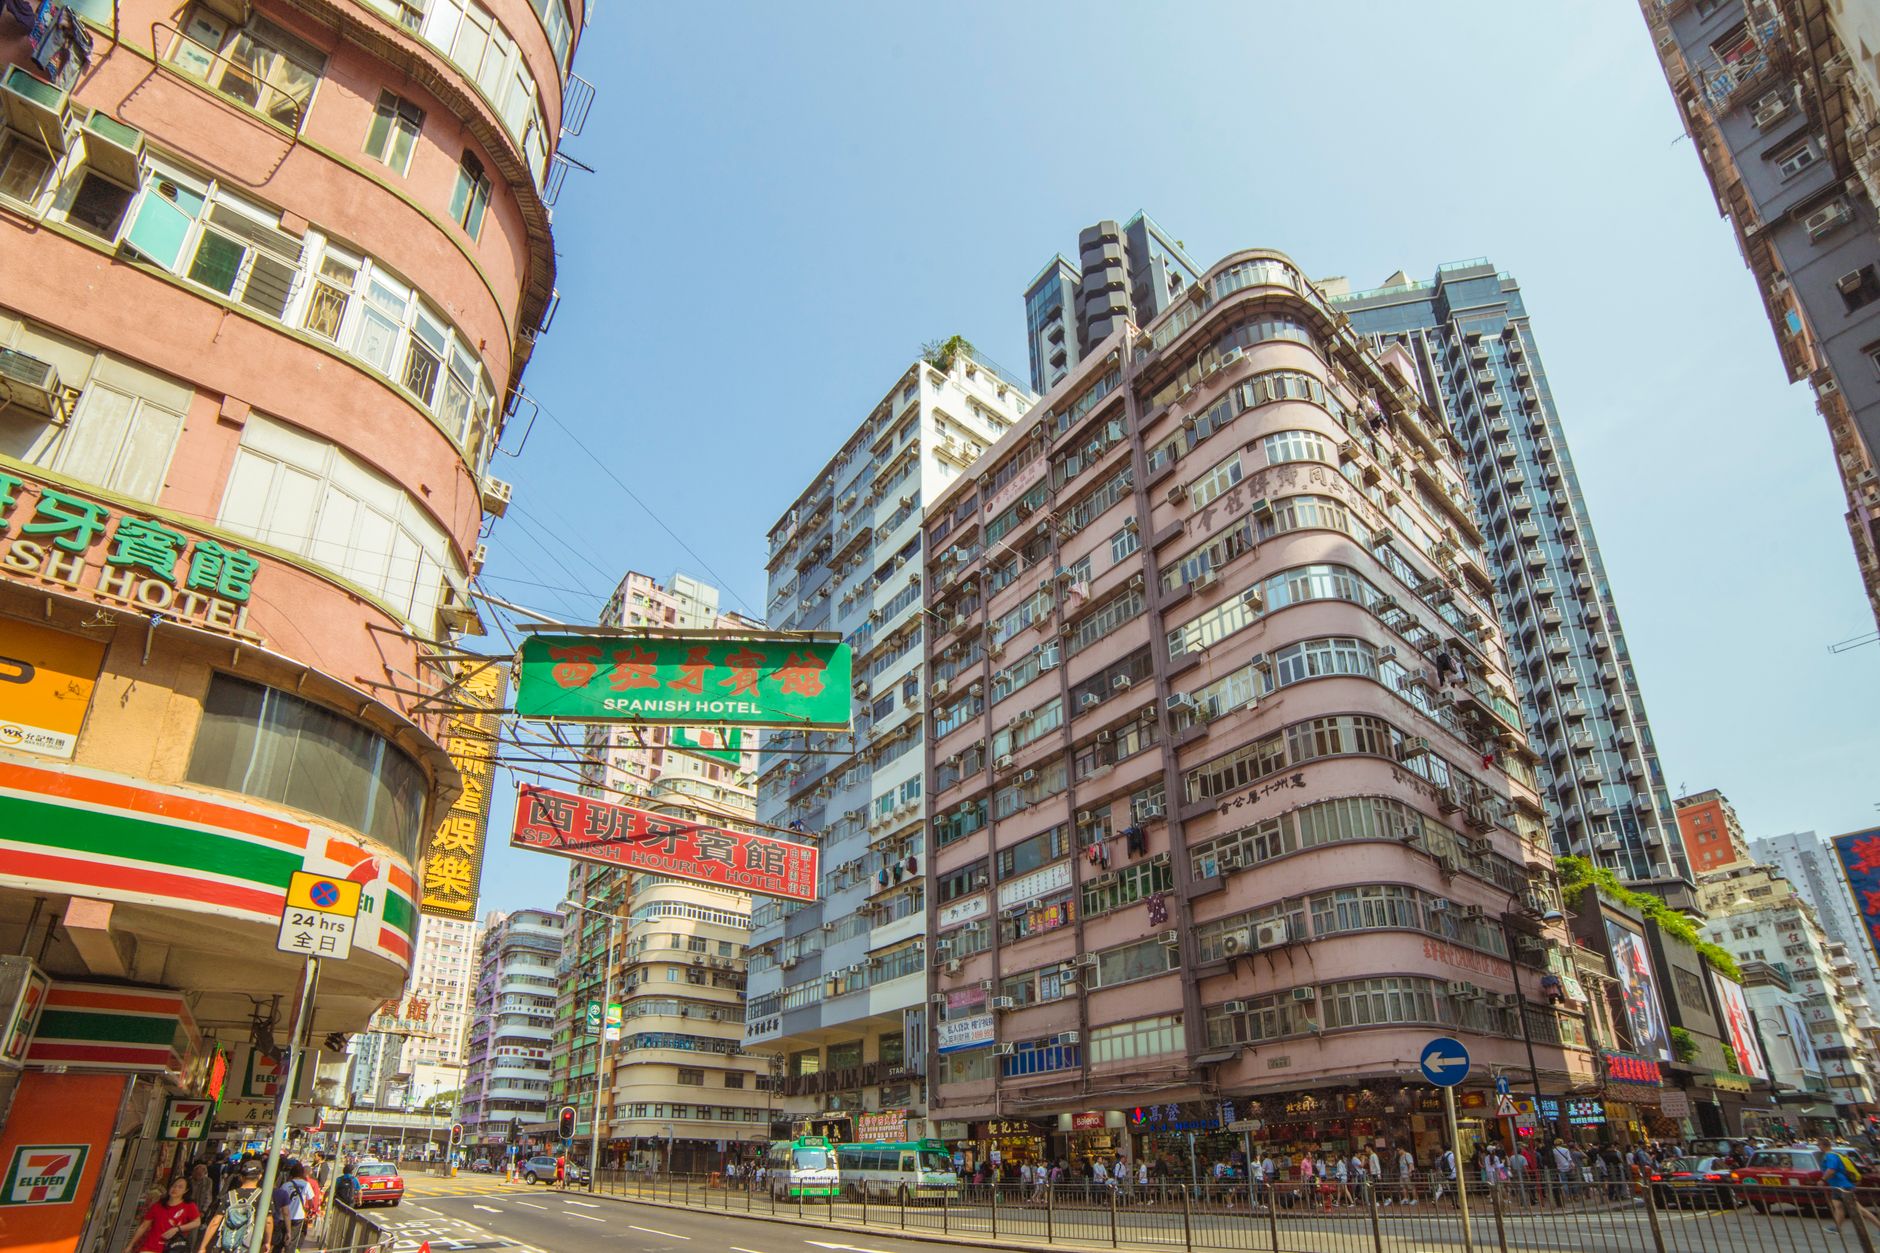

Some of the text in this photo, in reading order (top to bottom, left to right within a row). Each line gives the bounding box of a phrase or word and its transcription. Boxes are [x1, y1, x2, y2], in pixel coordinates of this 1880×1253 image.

[97, 565, 265, 641] HOTEL
[548, 645, 828, 697] 西班牙賓館
[603, 698, 763, 714] SPANISH HOTEL
[528, 790, 787, 877] 西班牙賓館
[521, 828, 786, 891] SPANISH HOURLY HOTEL
[291, 913, 345, 933] 24 hrs
[292, 931, 336, 952] 全日
[256, 1074, 278, 1083] ELEV
[1076, 1116, 1100, 1126] Baleno
[26, 1154, 72, 1201] 7
